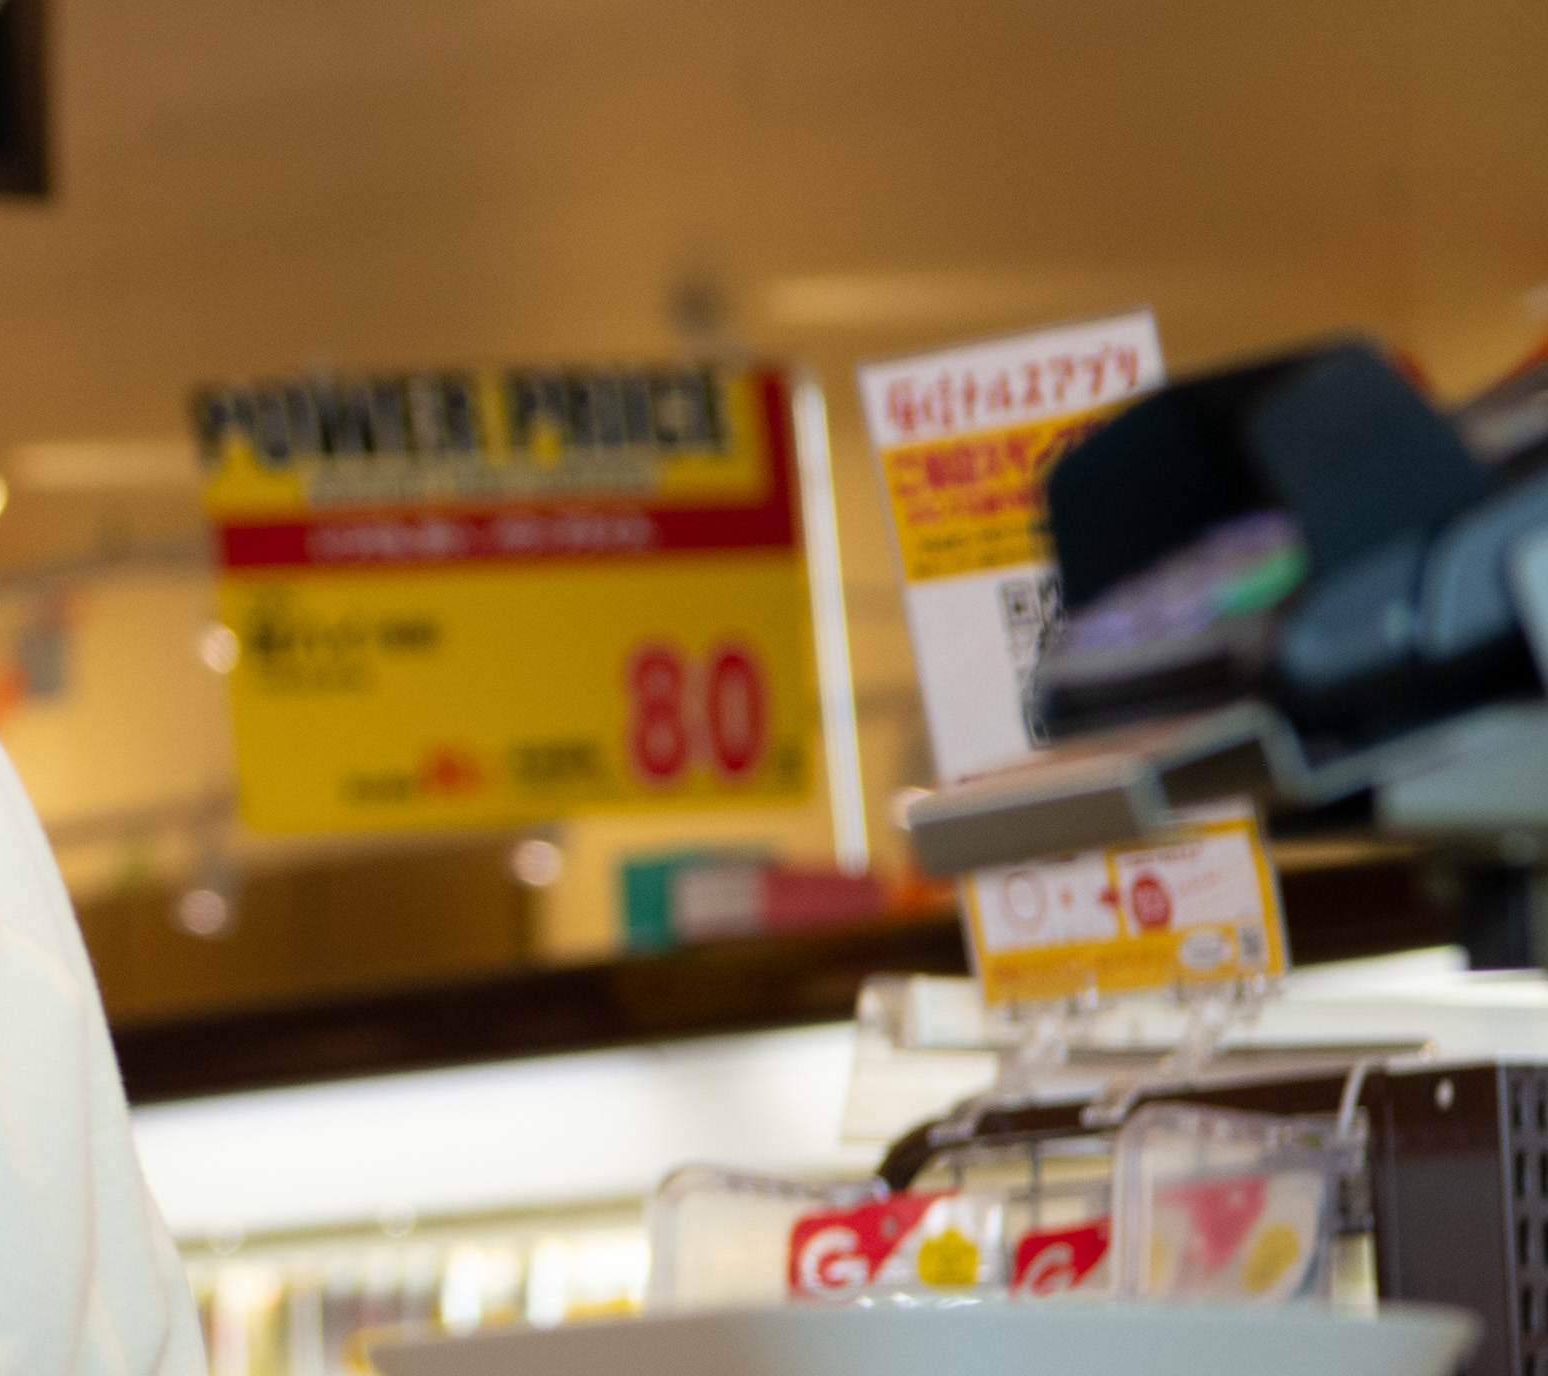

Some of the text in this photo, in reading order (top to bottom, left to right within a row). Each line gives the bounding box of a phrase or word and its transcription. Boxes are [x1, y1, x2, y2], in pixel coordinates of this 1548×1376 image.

[194, 366, 732, 469] POWER PRICE
[624, 637, 770, 791] 80
